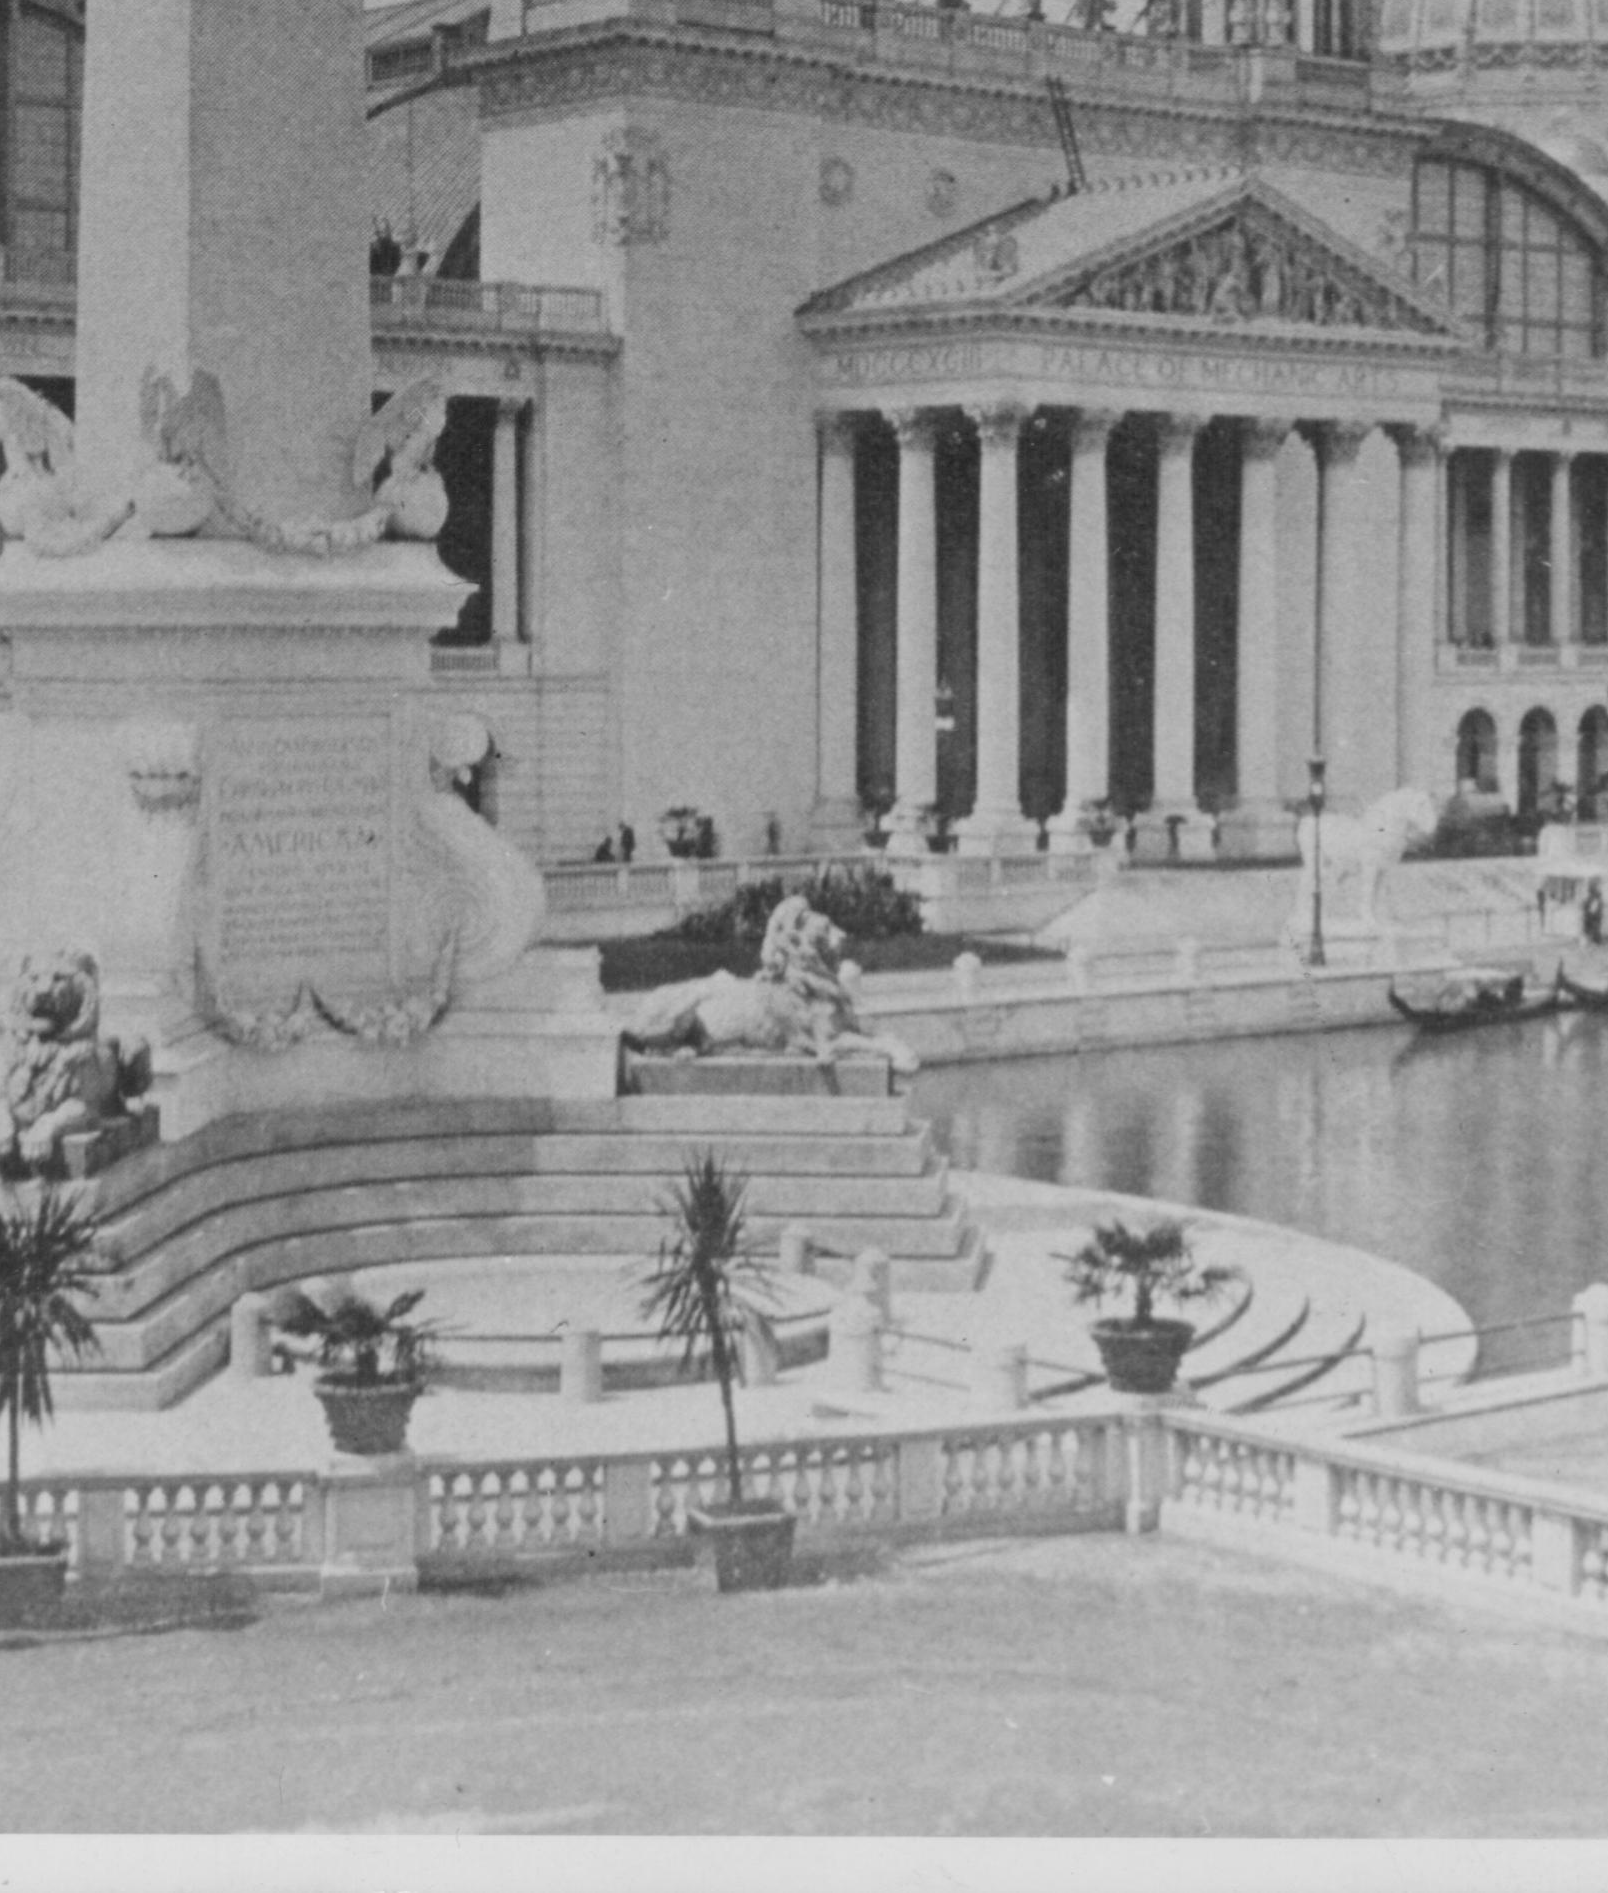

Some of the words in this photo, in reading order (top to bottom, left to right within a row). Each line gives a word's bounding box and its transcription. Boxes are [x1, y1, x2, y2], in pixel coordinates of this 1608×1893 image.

[1042, 346, 1143, 381] PALACE
[1157, 356, 1186, 382] OF
[1199, 359, 1326, 391] MECHANIC
[1336, 365, 1399, 394] ARTS
